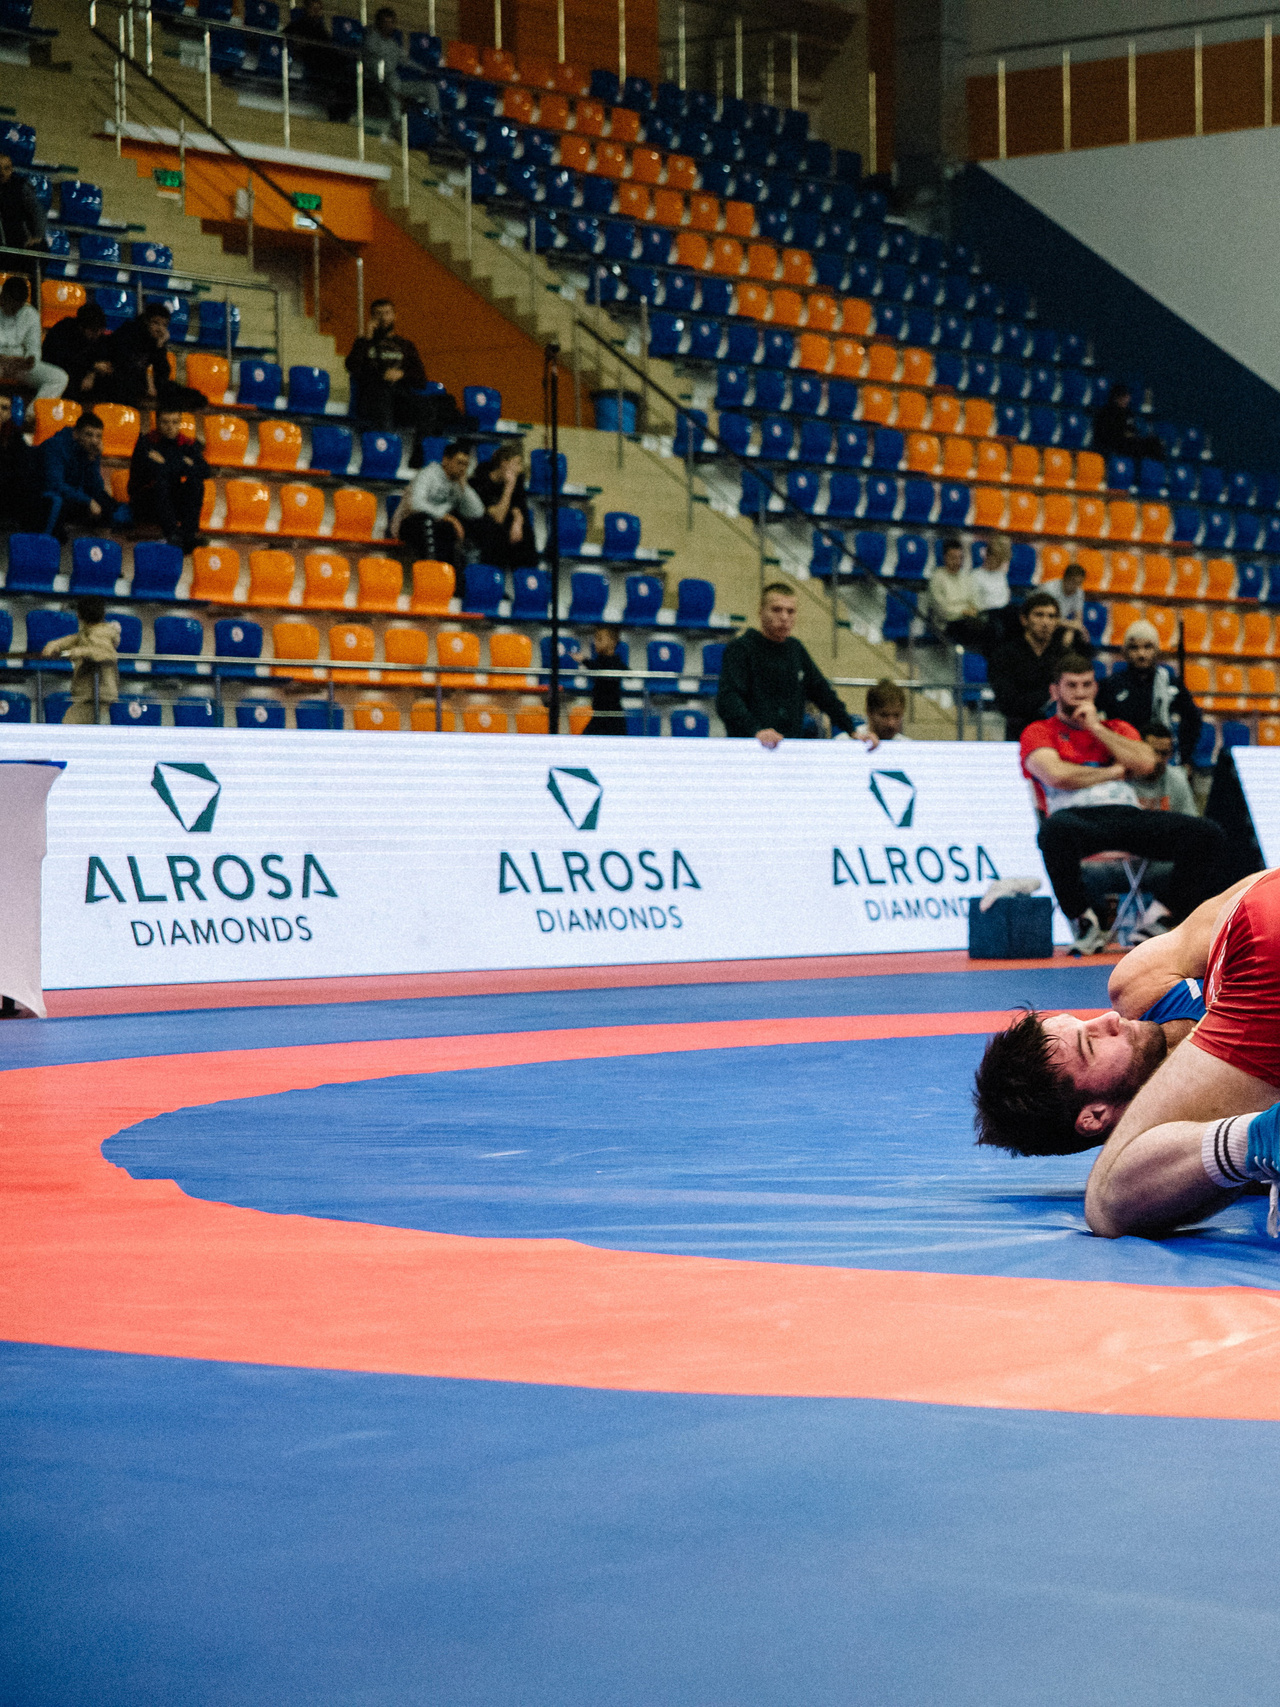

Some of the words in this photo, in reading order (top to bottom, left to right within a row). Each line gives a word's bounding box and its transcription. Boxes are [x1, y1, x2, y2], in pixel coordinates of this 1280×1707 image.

[85, 854, 339, 904] ALROSA
[499, 850, 702, 893] ALROSA
[833, 845, 1000, 885] ALROSA
[536, 905, 683, 933] DIAMONDS
[864, 897, 969, 921] DIAMOND
[131, 916, 313, 946] DIAMONDS
